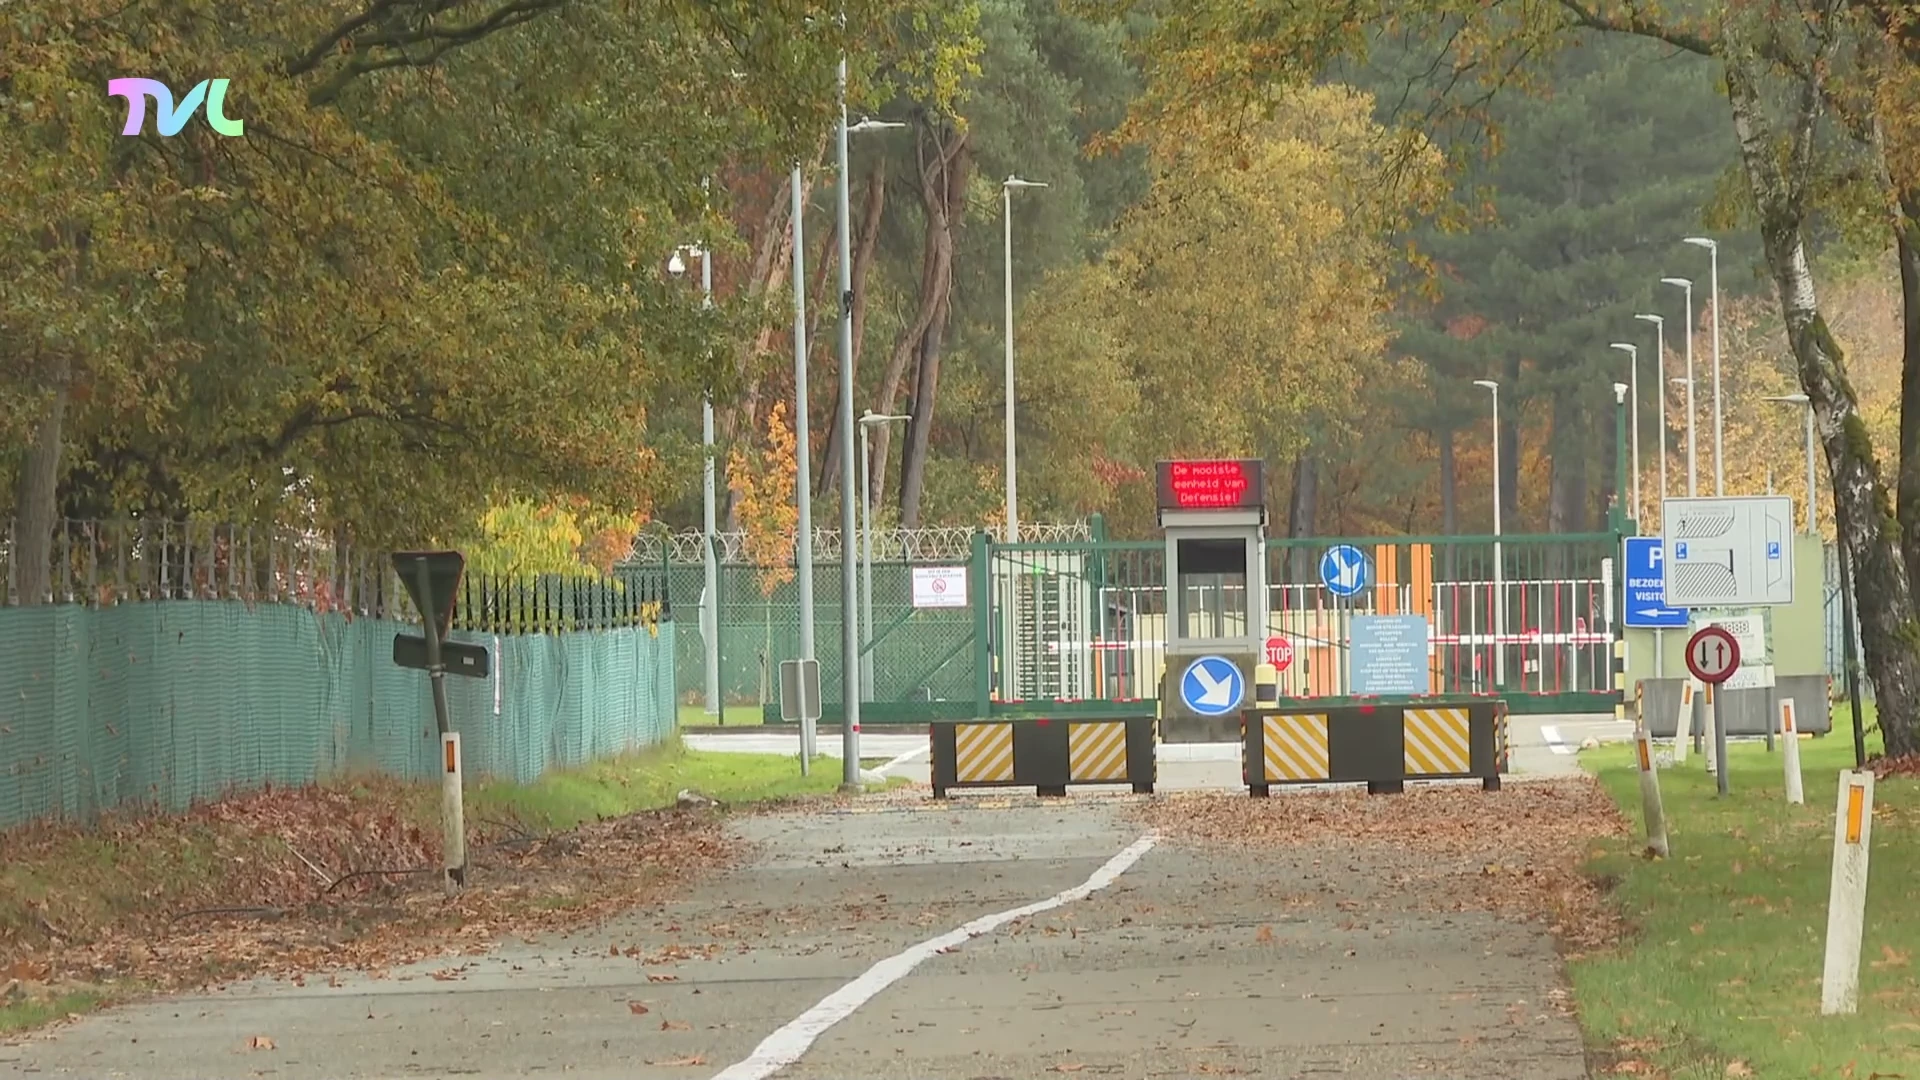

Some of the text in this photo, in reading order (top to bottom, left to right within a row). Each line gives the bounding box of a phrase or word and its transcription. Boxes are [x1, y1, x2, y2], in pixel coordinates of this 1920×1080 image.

[1173, 464, 1238, 475] De mooiste
[1174, 480, 1245, 489] eenheid van
[1180, 492, 1237, 503] Defensie!
[1649, 546, 1664, 569] P
[1265, 647, 1292, 663] STOP
